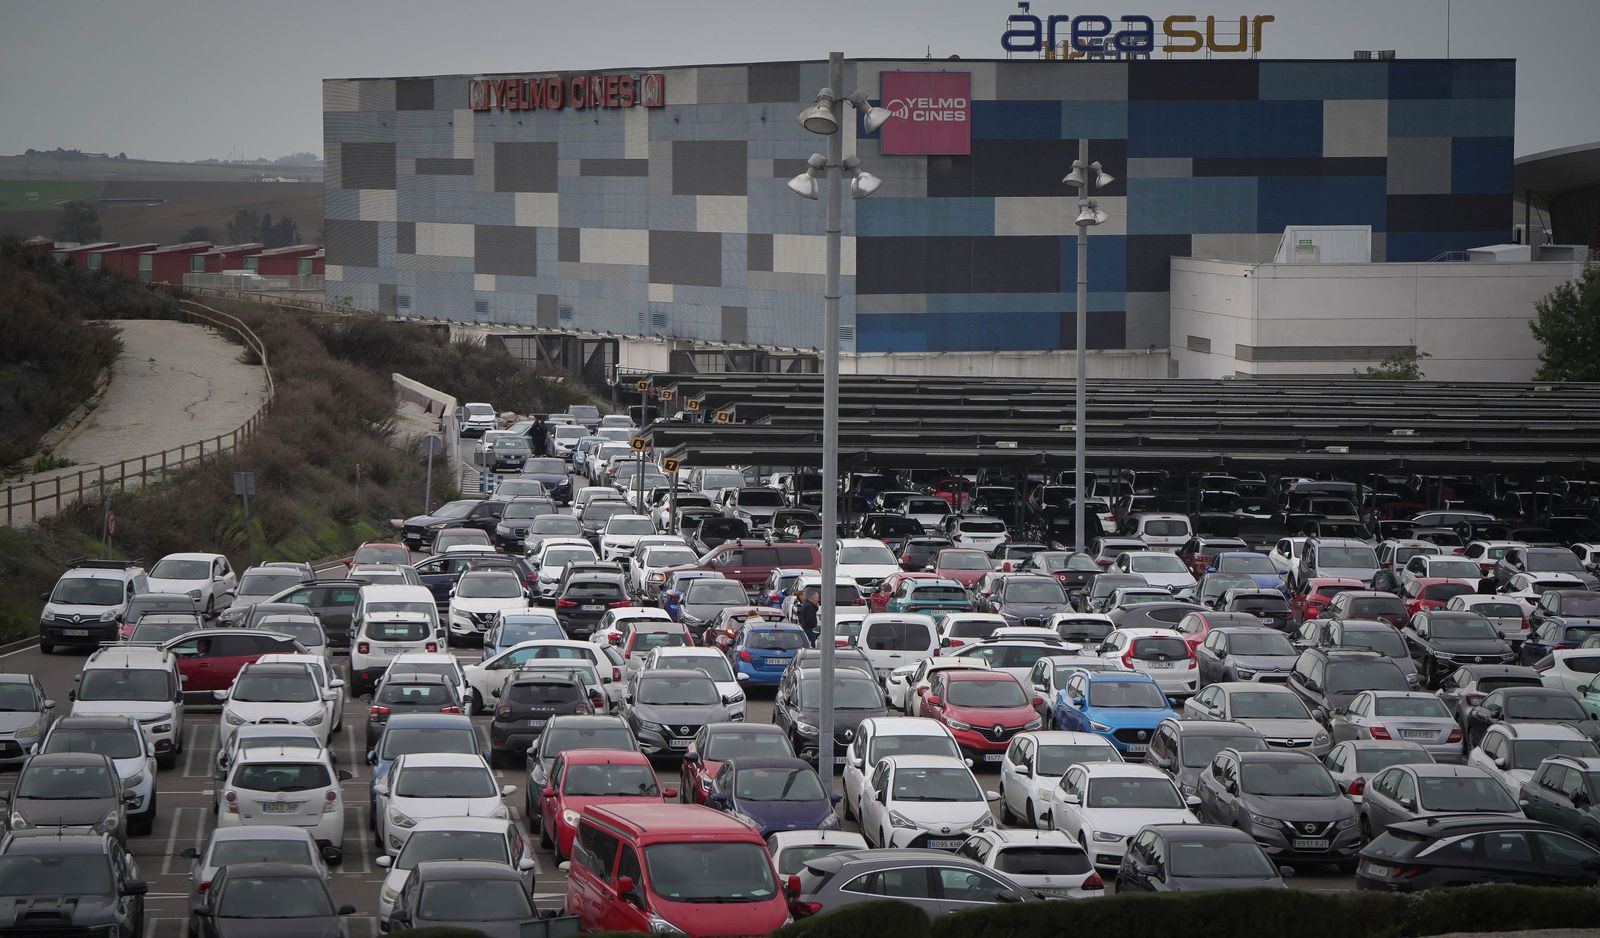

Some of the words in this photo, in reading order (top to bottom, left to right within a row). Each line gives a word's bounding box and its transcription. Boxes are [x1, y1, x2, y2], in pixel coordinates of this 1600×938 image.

[490, 78, 564, 110] YELMO
[570, 75, 636, 108] CINES
[905, 97, 967, 109] YELMO
[912, 110, 967, 121] CINES
